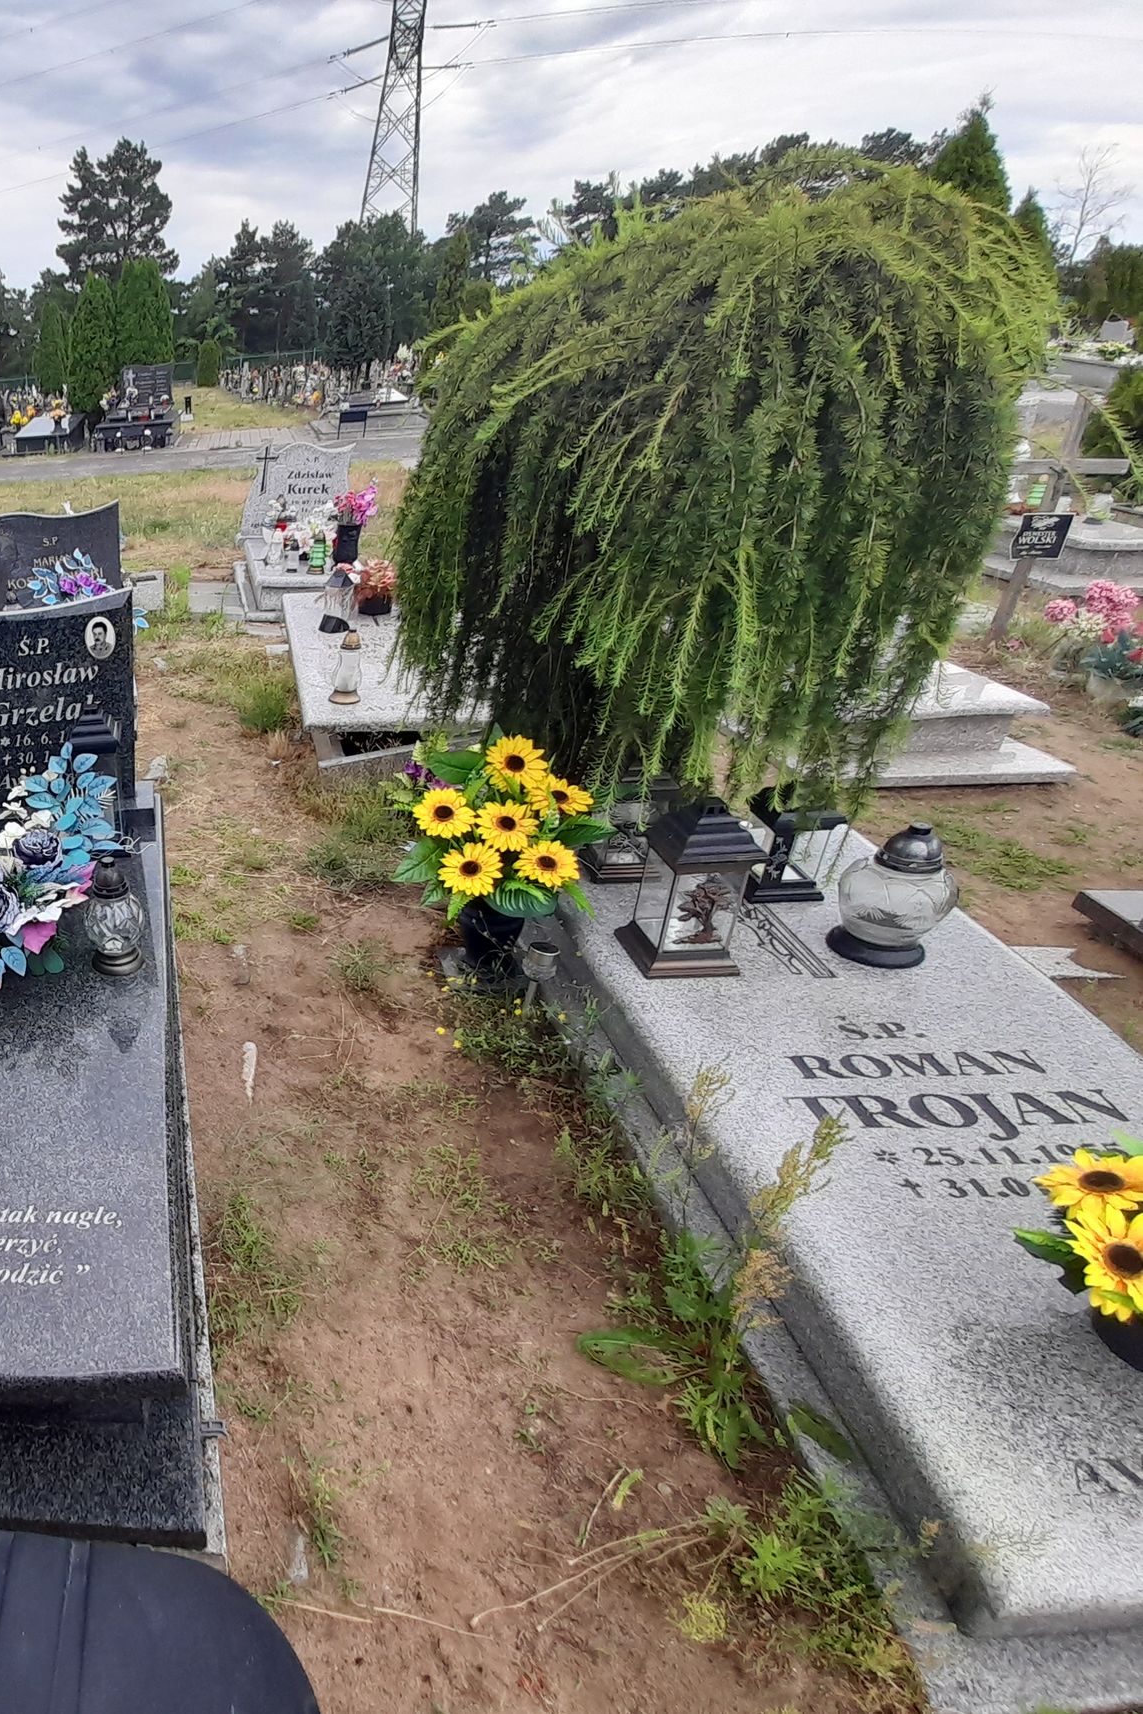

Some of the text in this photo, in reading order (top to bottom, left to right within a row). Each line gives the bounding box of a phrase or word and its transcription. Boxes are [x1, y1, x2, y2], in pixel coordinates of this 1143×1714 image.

[287, 483, 331, 495] Kurek
[1018, 535, 1057, 545] WOLSKI
[18, 635, 50, 657] Ś.P.
[784, 1049, 1048, 1080] ROMAN
[782, 1088, 1131, 1142] TROJAN
[45, 1205, 124, 1230] nagle,
